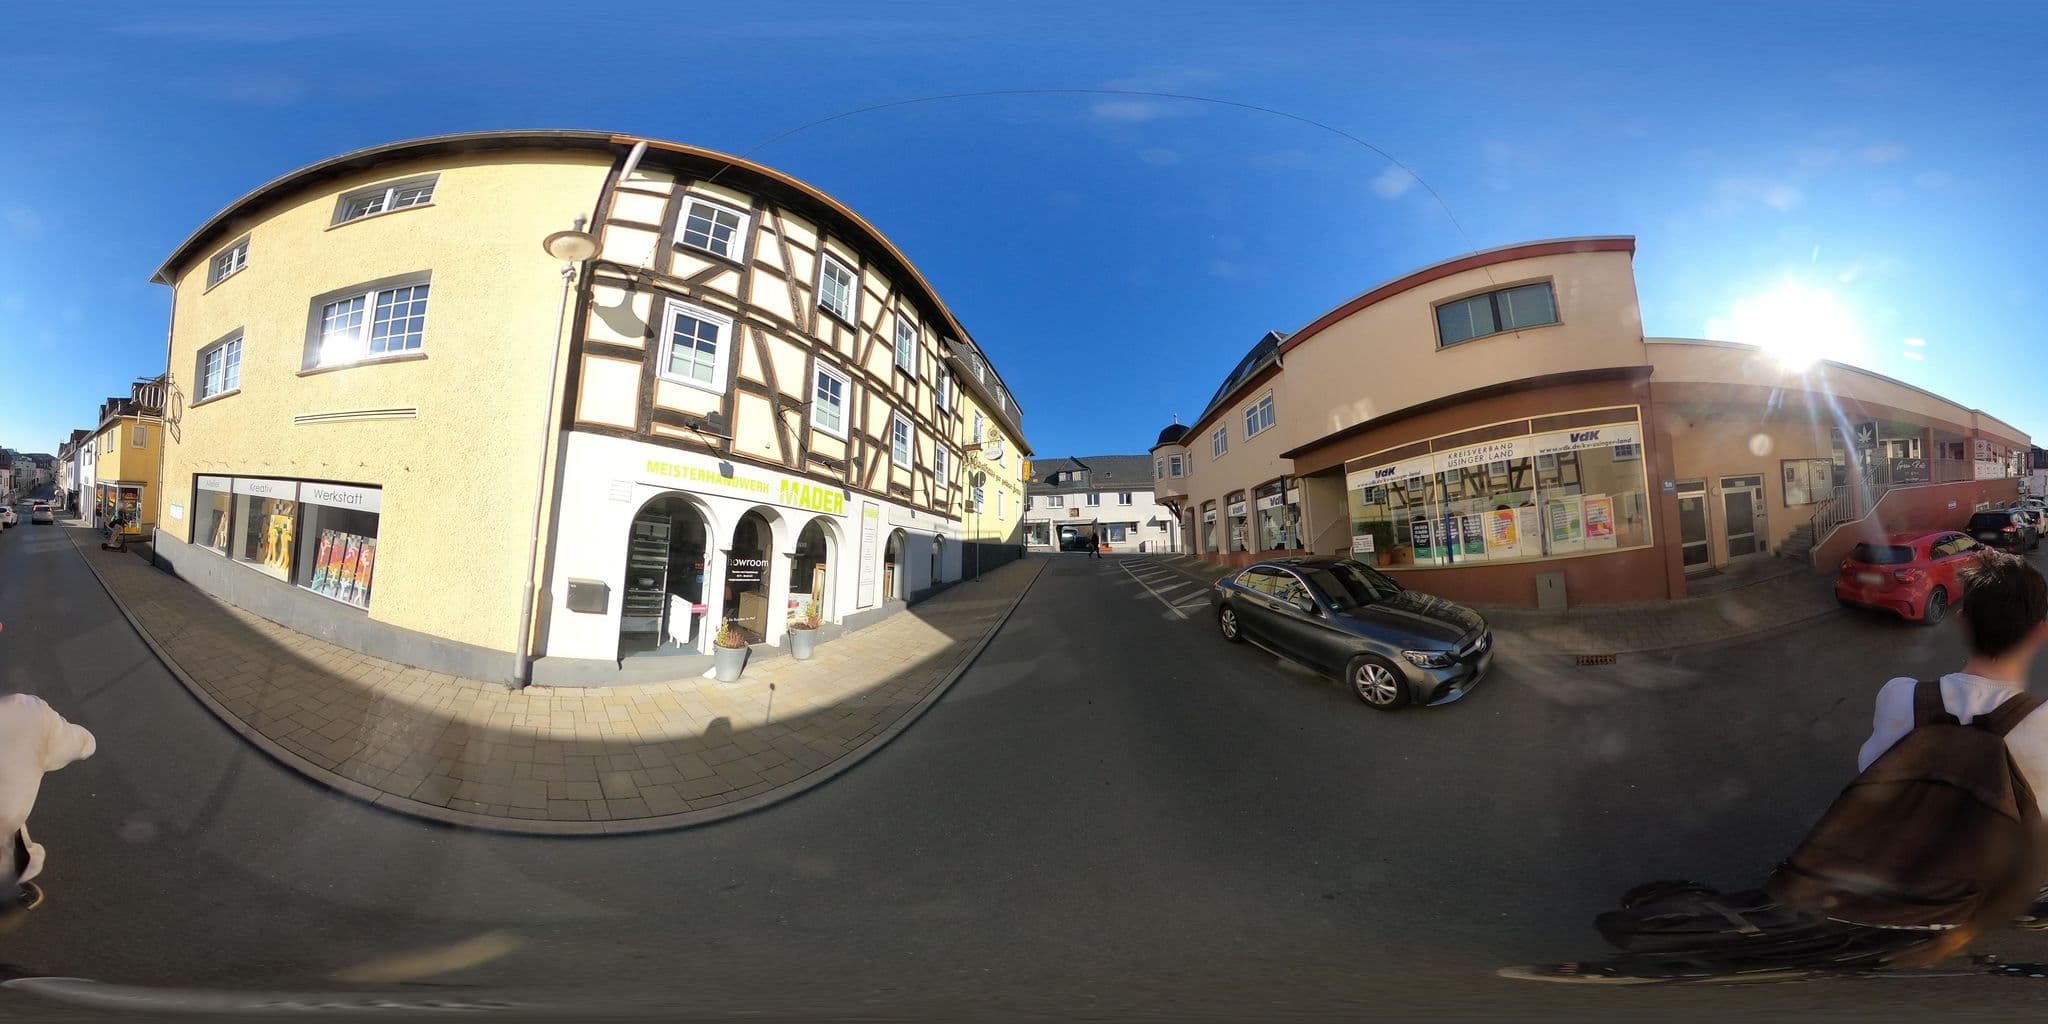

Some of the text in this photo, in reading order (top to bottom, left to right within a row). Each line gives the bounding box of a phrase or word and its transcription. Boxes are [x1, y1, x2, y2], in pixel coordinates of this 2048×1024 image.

[1570, 430, 1600, 443] VdK
[1447, 450, 1514, 468] USINGER LAND
[1448, 442, 1513, 459] KREISVERBAND
[646, 460, 770, 494] MEISTERHANDWERK
[1374, 466, 1396, 479] VdK
[249, 483, 273, 495] Kreativ
[313, 488, 363, 505] Werkstatt
[779, 479, 844, 514] MADER
